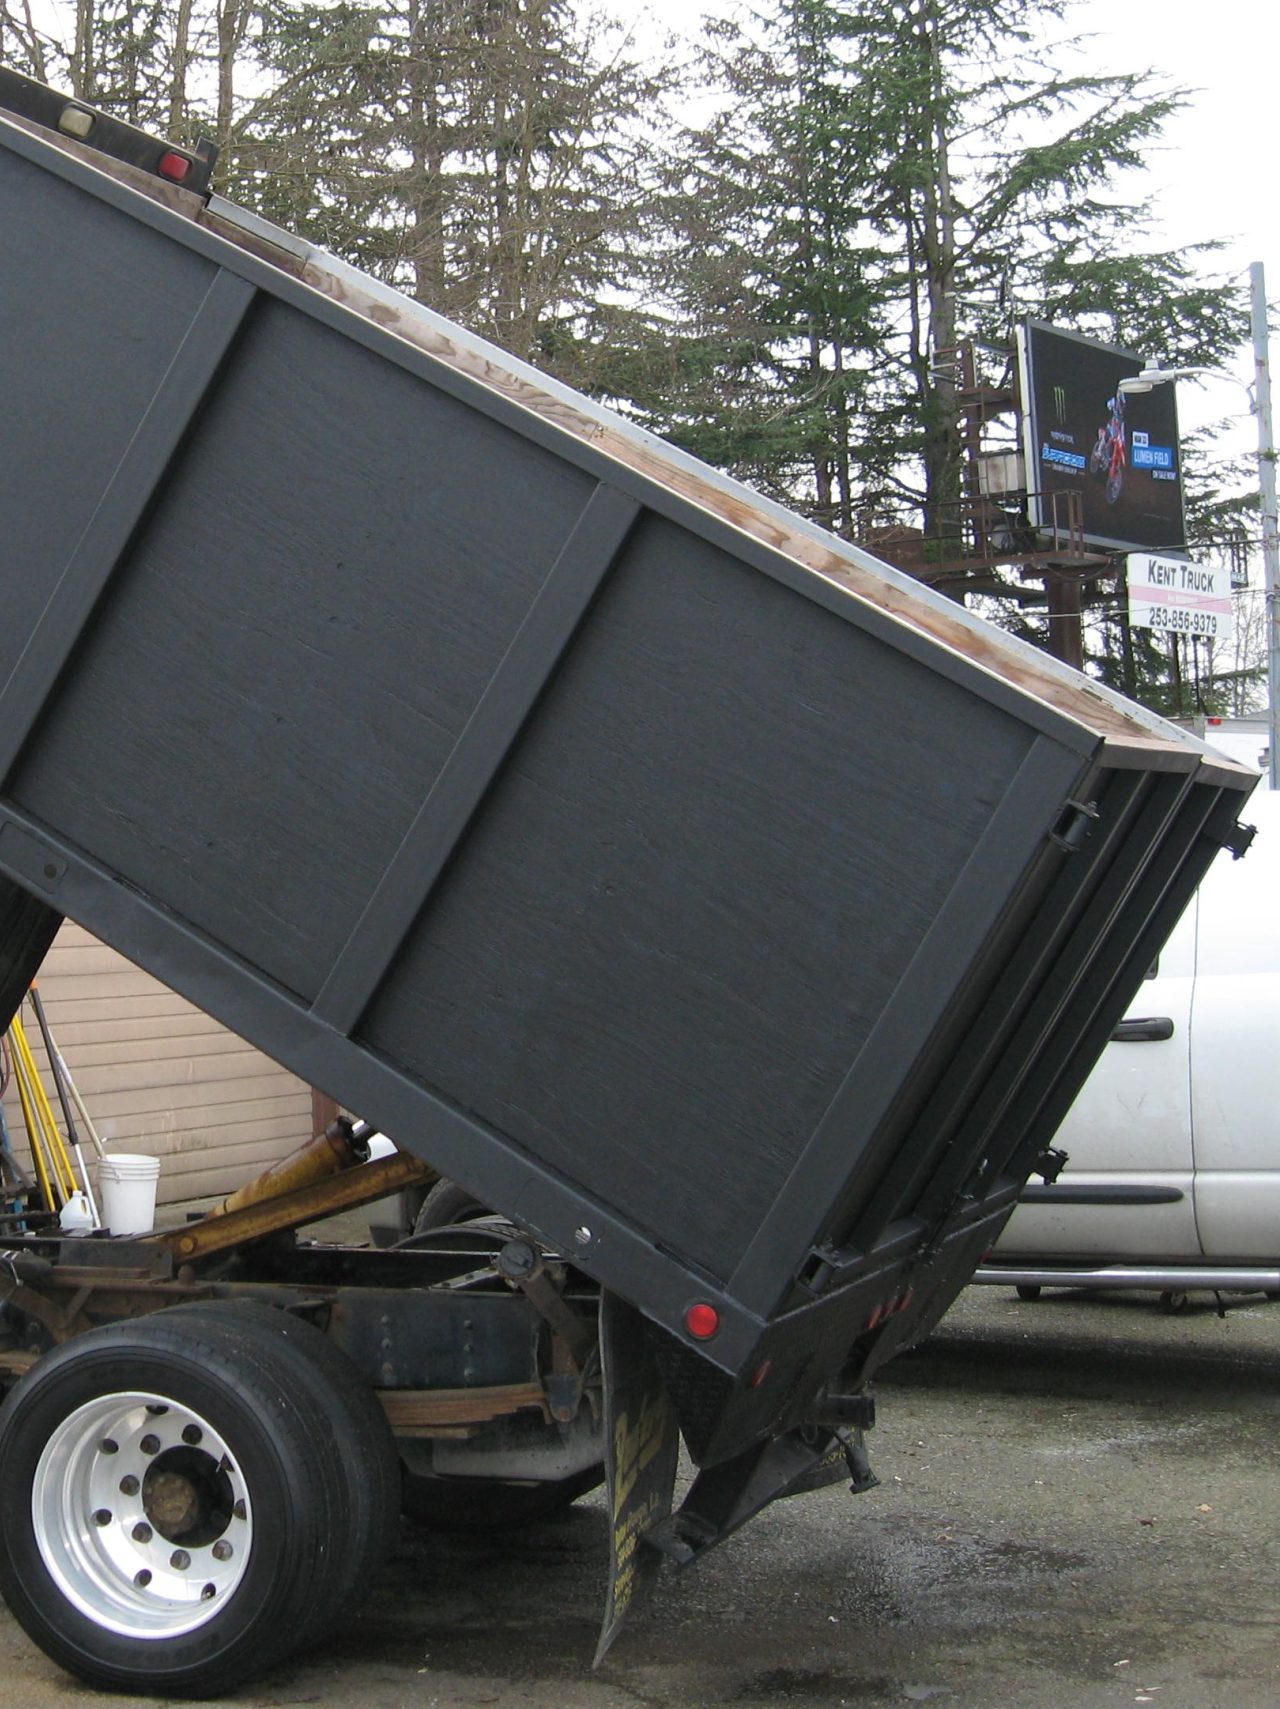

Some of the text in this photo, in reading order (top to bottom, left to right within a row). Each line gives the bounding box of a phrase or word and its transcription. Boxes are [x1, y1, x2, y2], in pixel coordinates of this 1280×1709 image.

[1134, 448, 1169, 466] LUMEN FIELD
[1148, 559, 1214, 593] KENT TRUCK
[1149, 607, 1217, 634] 253-856-9379
